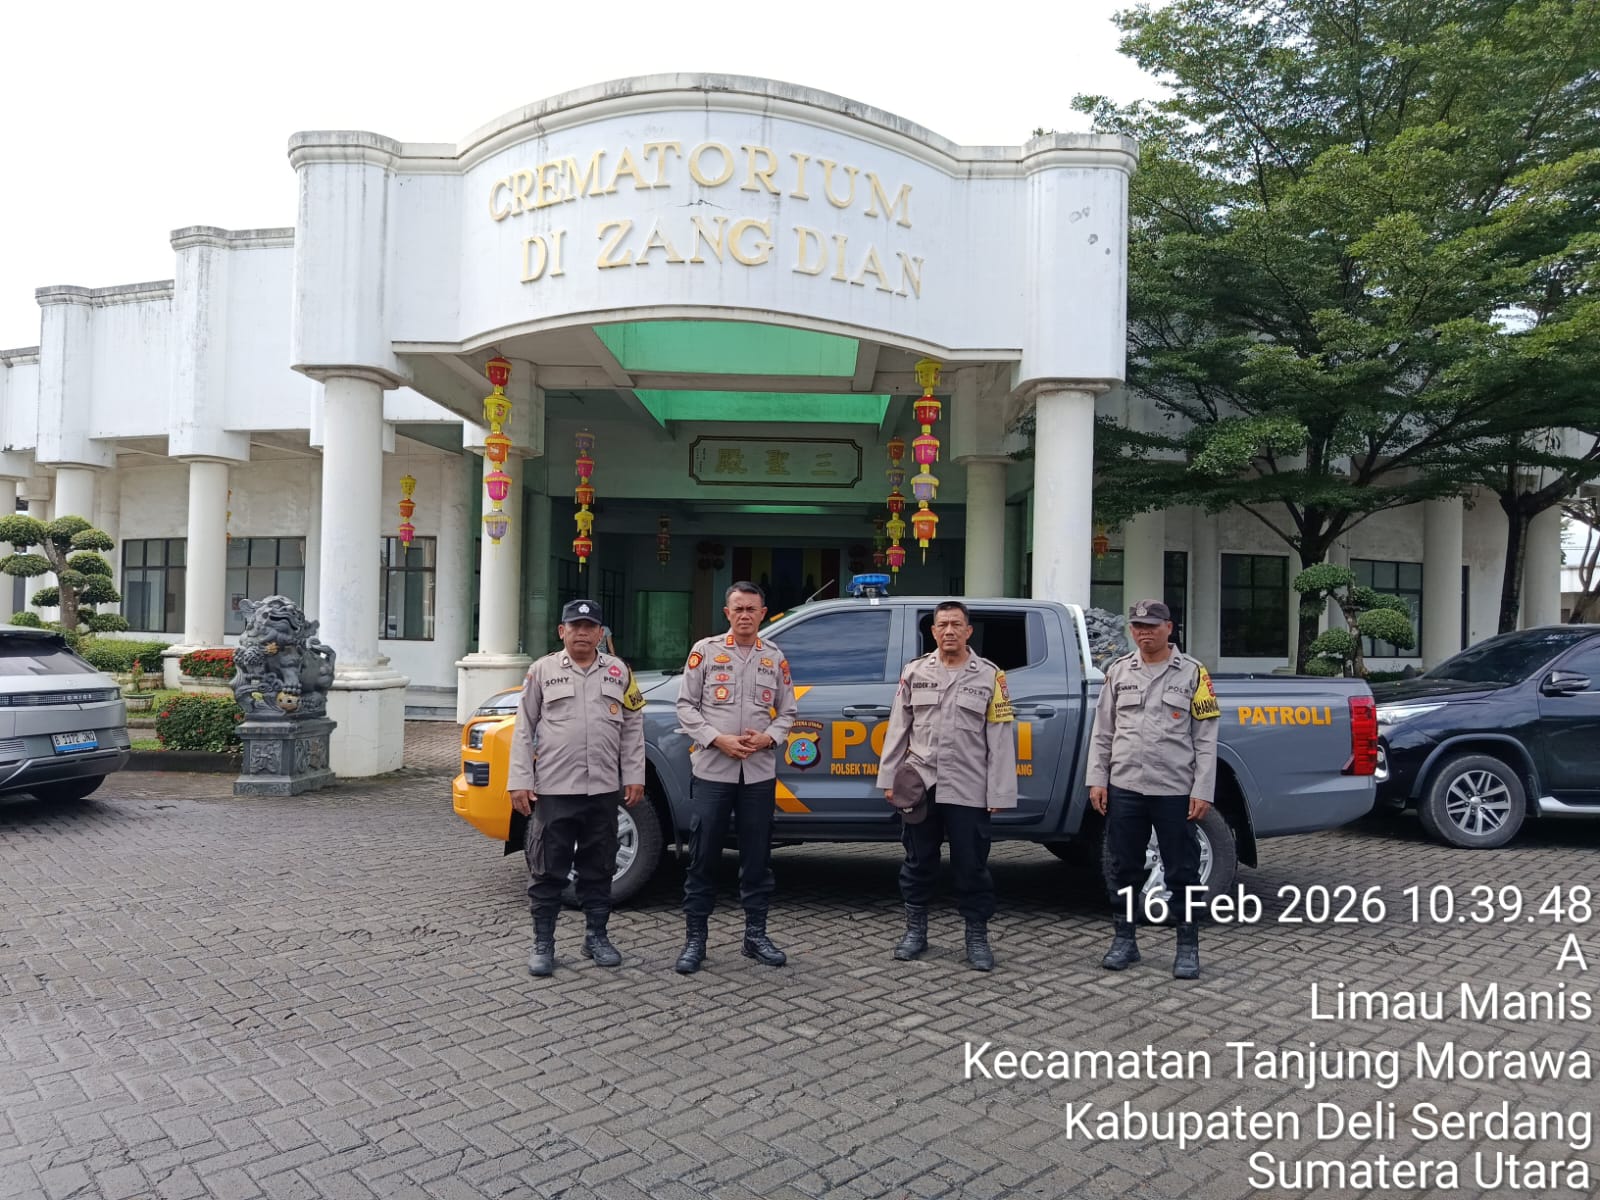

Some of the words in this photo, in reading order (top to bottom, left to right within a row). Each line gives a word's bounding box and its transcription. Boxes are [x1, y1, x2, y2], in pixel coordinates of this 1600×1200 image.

[488, 139, 914, 228] CREMATORIUM
[520, 229, 567, 285] DI
[595, 214, 775, 271] ZANG
[791, 224, 926, 300] DIAN
[545, 676, 570, 688] SONY
[963, 686, 986, 697] POLRI
[1237, 706, 1332, 727] PATROLI
[831, 763, 861, 776] POLSEK
